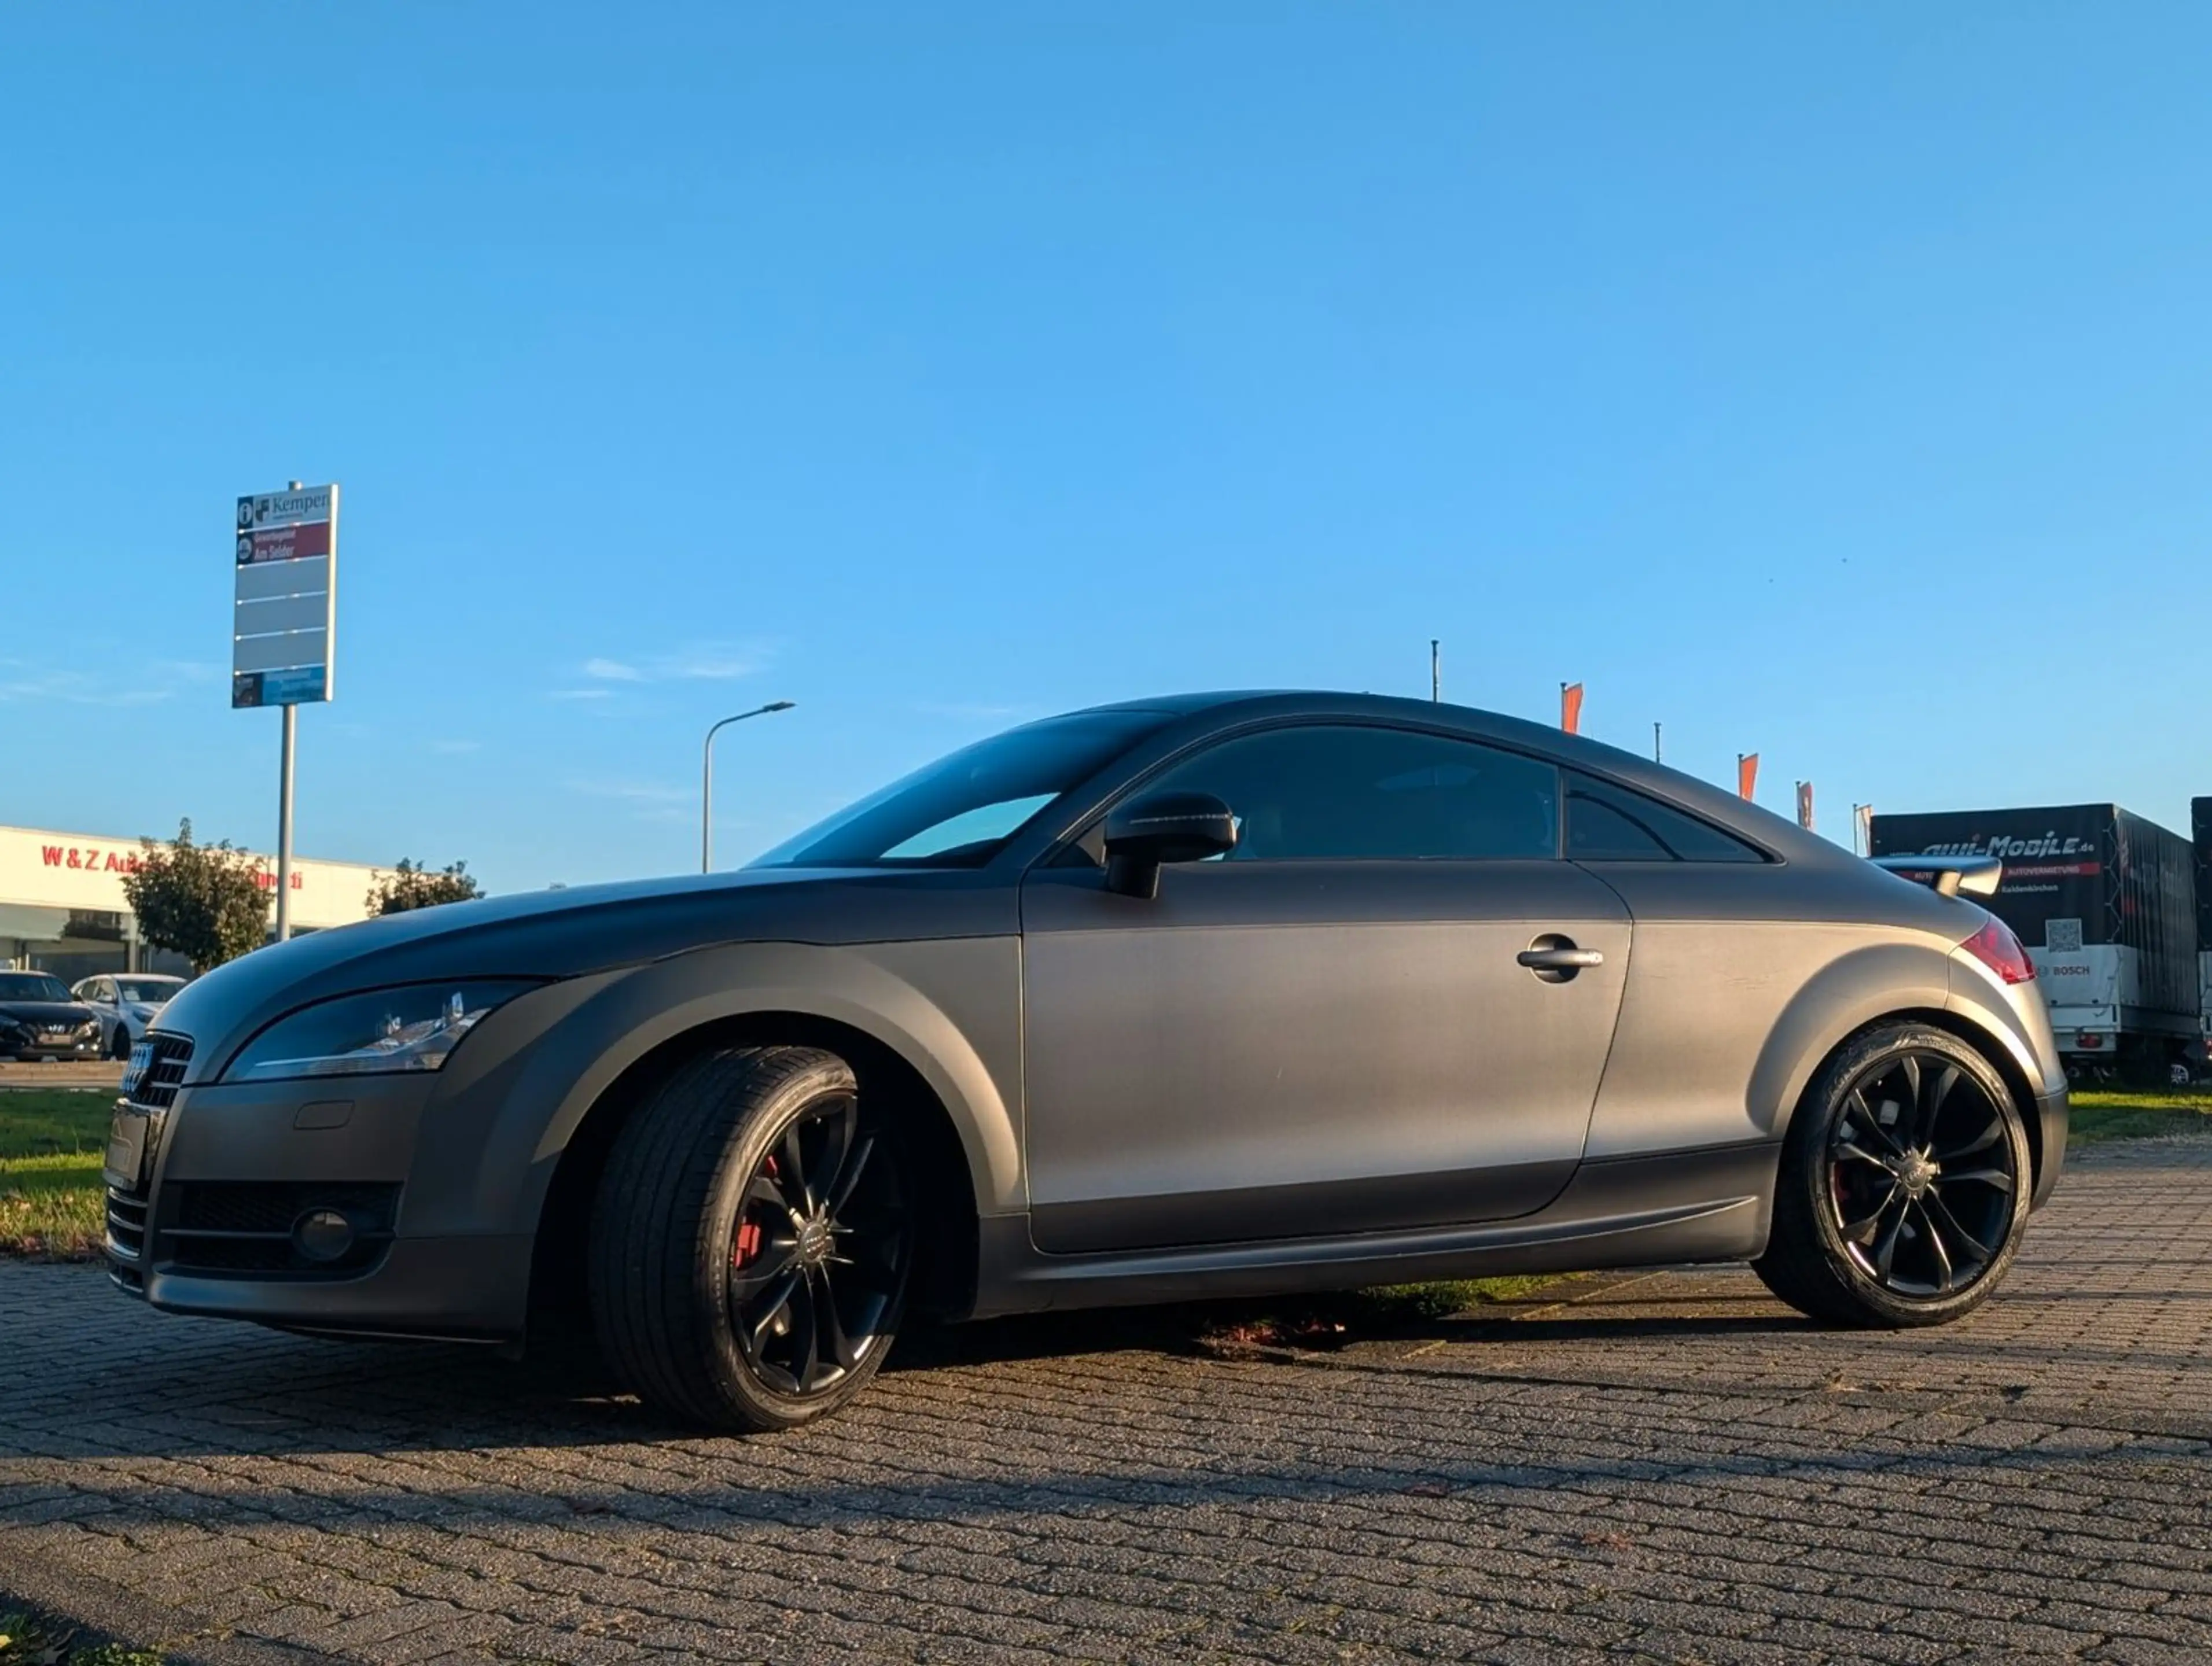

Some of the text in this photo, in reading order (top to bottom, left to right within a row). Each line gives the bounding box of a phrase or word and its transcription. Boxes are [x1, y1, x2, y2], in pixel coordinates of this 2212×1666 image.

[272, 494, 330, 513] Kempen
[42, 845, 63, 867] W
[67, 847, 82, 868] &
[85, 850, 100, 871] Z
[2053, 965, 2090, 976] BOSCH
